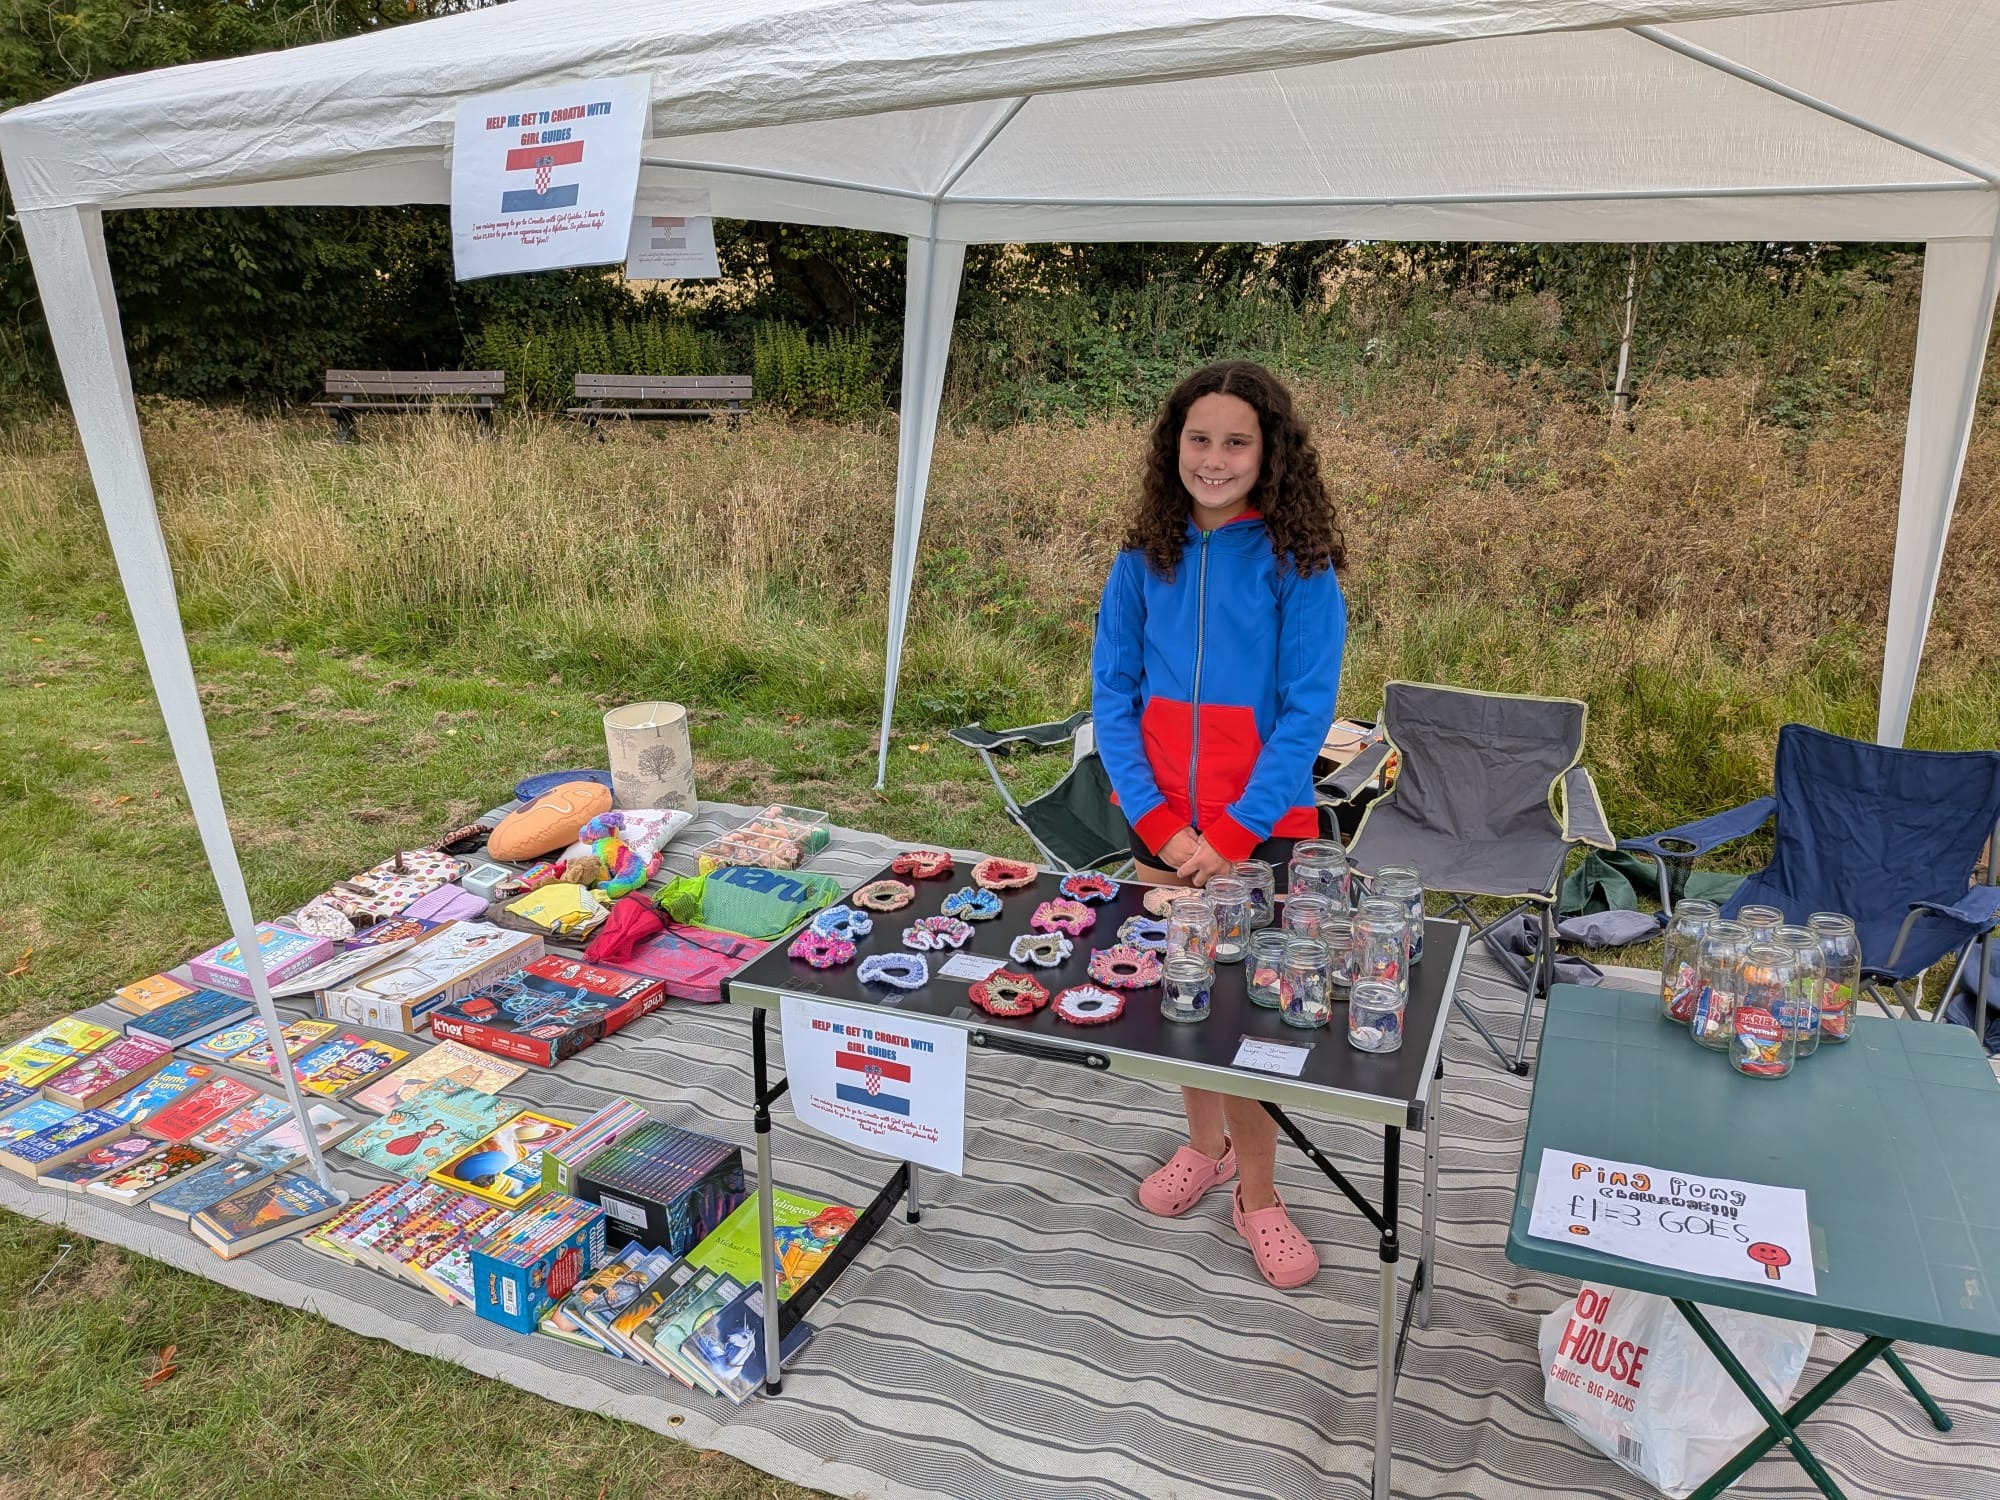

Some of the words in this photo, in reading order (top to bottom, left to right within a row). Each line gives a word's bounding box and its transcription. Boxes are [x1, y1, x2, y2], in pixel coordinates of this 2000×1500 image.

[486, 116, 506, 130] HELP
[507, 114, 520, 128] ME
[521, 112, 537, 126] GET
[539, 111, 550, 124] TO
[551, 105, 586, 122] CROATIA
[587, 102, 611, 116] WITH
[520, 132, 540, 145] GIRL
[541, 128, 572, 143] GUIDES
[812, 1019, 831, 1032] HELP
[832, 1023, 845, 1034] ME
[846, 1025, 861, 1038] GET
[862, 1028, 873, 1040] TO
[875, 1031, 909, 1048] CROATIA
[911, 1038, 934, 1053] WITH
[847, 1041, 866, 1054] GIRL
[867, 1045, 897, 1061] GUIDES
[145, 1079, 186, 1092] Drama
[154, 1071, 189, 1084] Llama
[1572, 1162, 1651, 1192] Ping
[1670, 1177, 1746, 1207] Pong
[1659, 1210, 1750, 1243] GOES
[714, 1236, 743, 1253] Michael
[1558, 1318, 1649, 1388] HOUSE
[1550, 1364, 1582, 1388] CHOICE
[1587, 1380, 1604, 1398] BIG
[1606, 1389, 1637, 1412] PACKS
